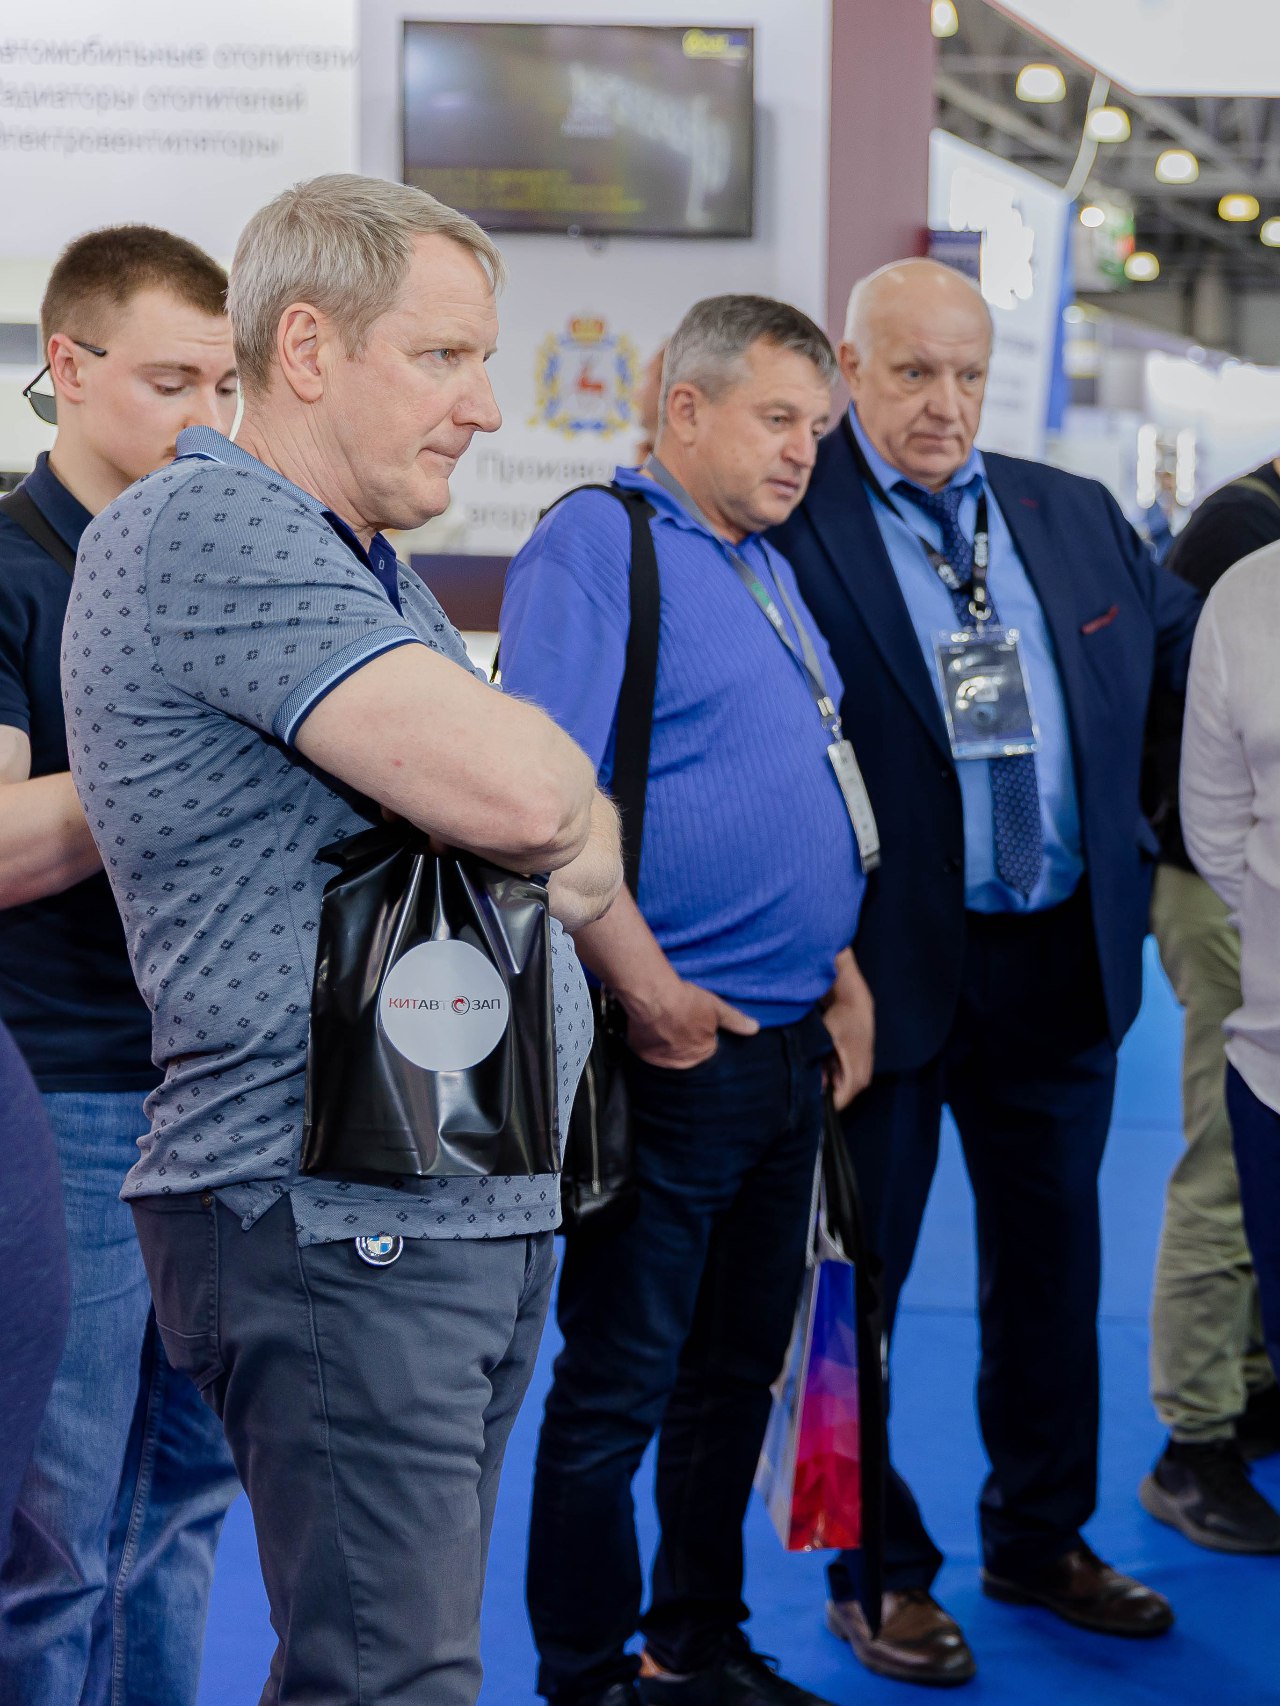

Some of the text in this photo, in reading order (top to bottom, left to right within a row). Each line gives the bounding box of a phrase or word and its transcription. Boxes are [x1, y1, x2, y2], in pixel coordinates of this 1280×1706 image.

[0, 35, 208, 68] втомобильные
[0, 82, 138, 113] адиаторы
[0, 126, 282, 160] лектровентиляторы
